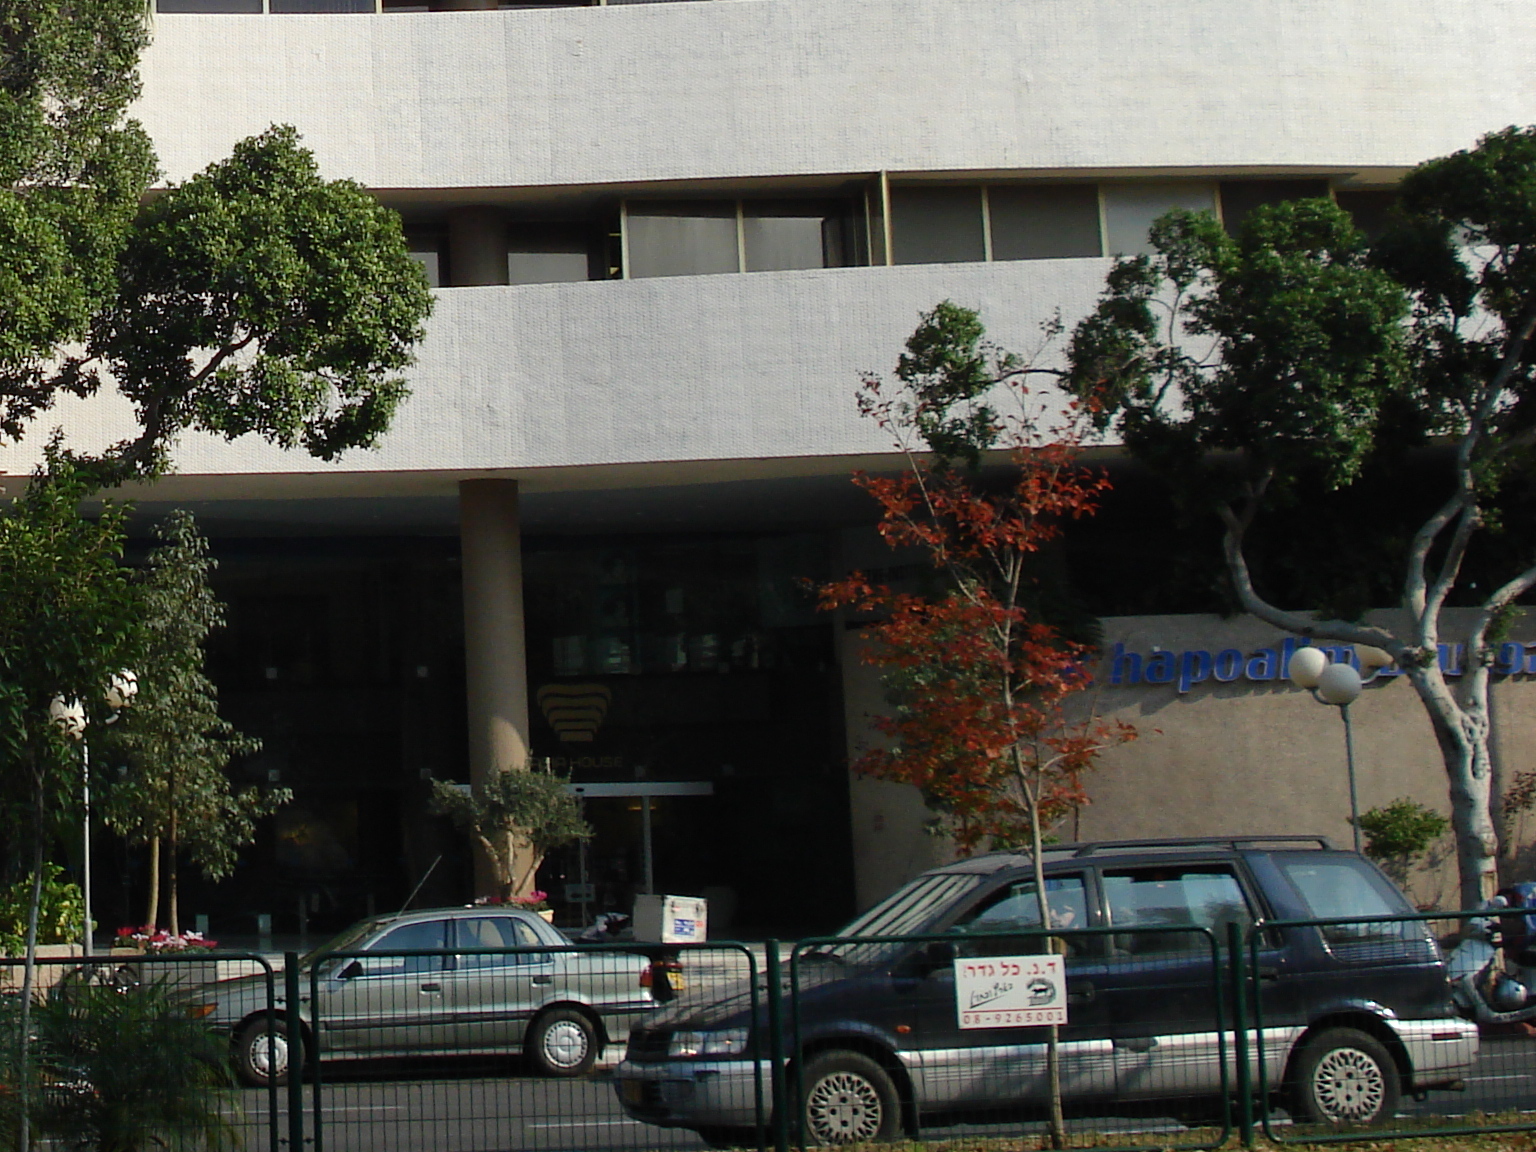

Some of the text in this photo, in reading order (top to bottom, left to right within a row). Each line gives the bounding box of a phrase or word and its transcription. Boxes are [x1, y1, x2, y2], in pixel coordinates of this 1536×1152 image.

[1111, 636, 1362, 693] hapoalm
[569, 756, 623, 768] HOUSE
[1000, 961, 1020, 976] כל
[963, 1011, 1063, 1025] 08-9265001
